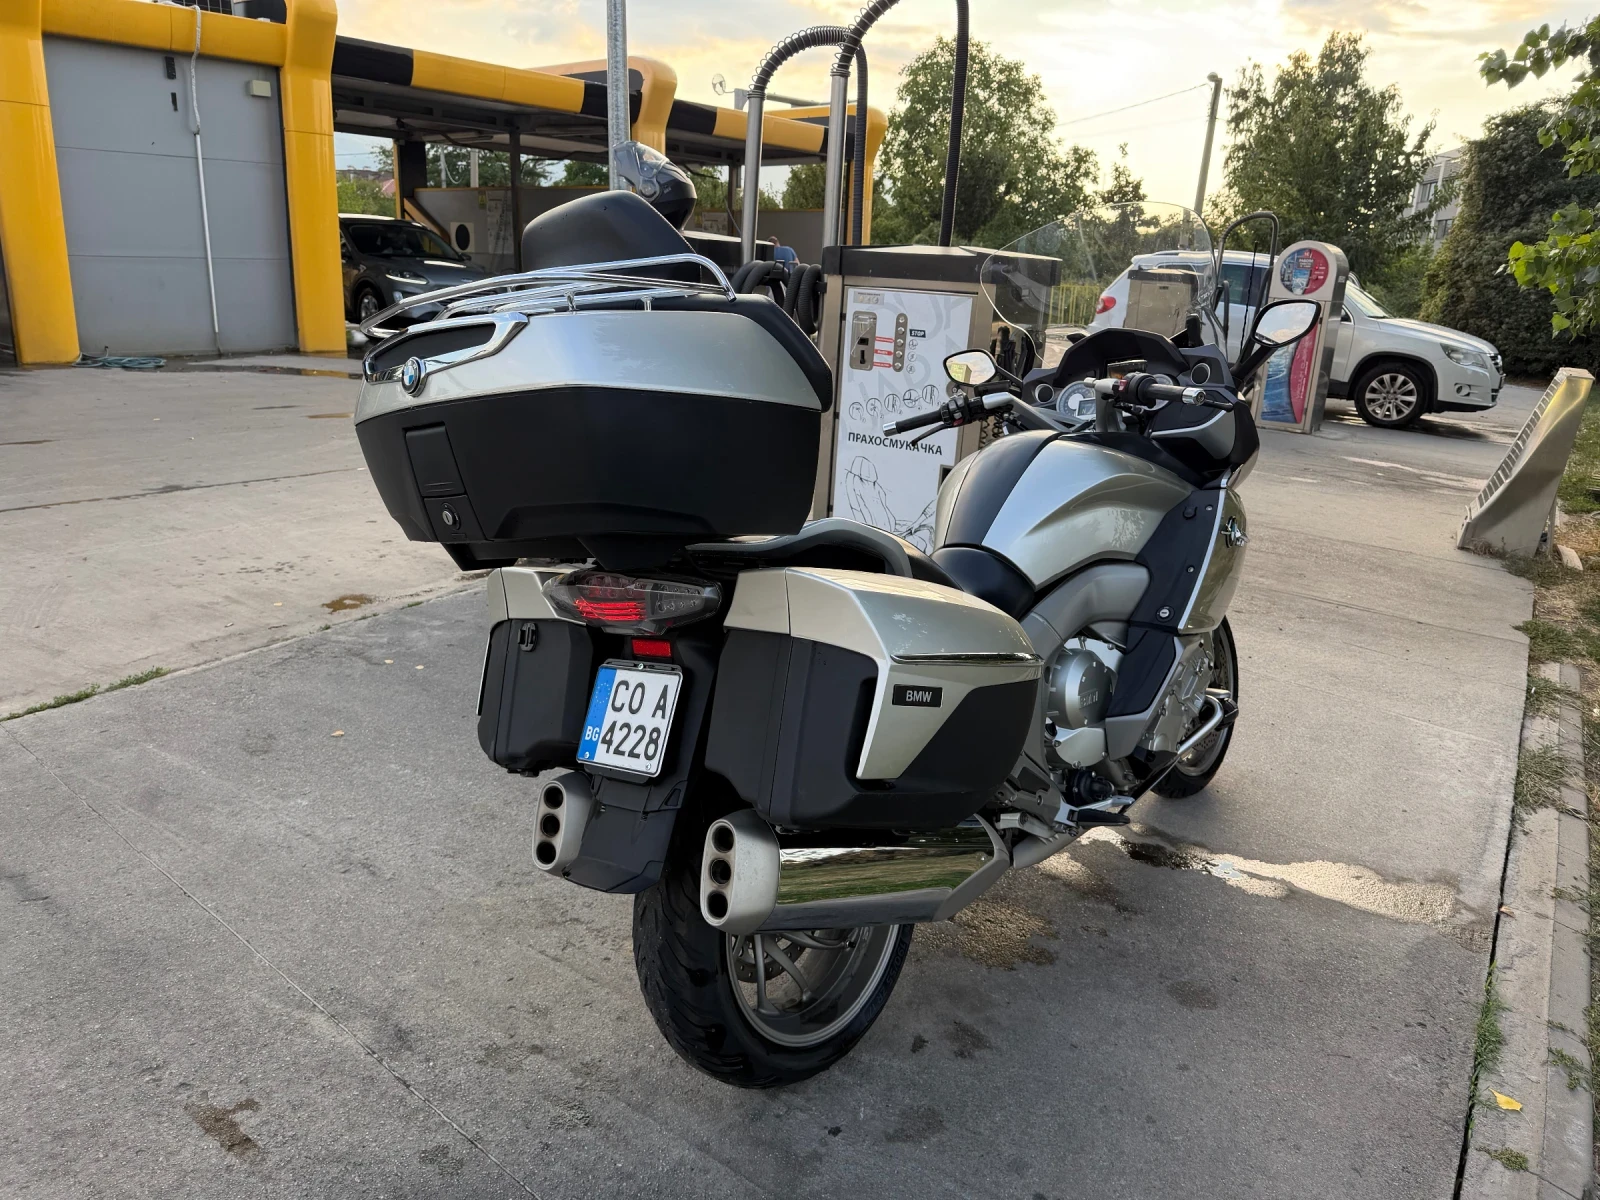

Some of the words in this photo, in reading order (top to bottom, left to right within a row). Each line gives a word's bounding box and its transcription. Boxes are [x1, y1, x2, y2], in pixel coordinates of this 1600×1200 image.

[848, 432, 943, 456] ПРАХОСМУКАЧКА
[611, 680, 646, 715] CO
[651, 684, 669, 719] A
[905, 690, 933, 703] BMW
[585, 725, 599, 742] BG
[600, 720, 661, 761] 4228
